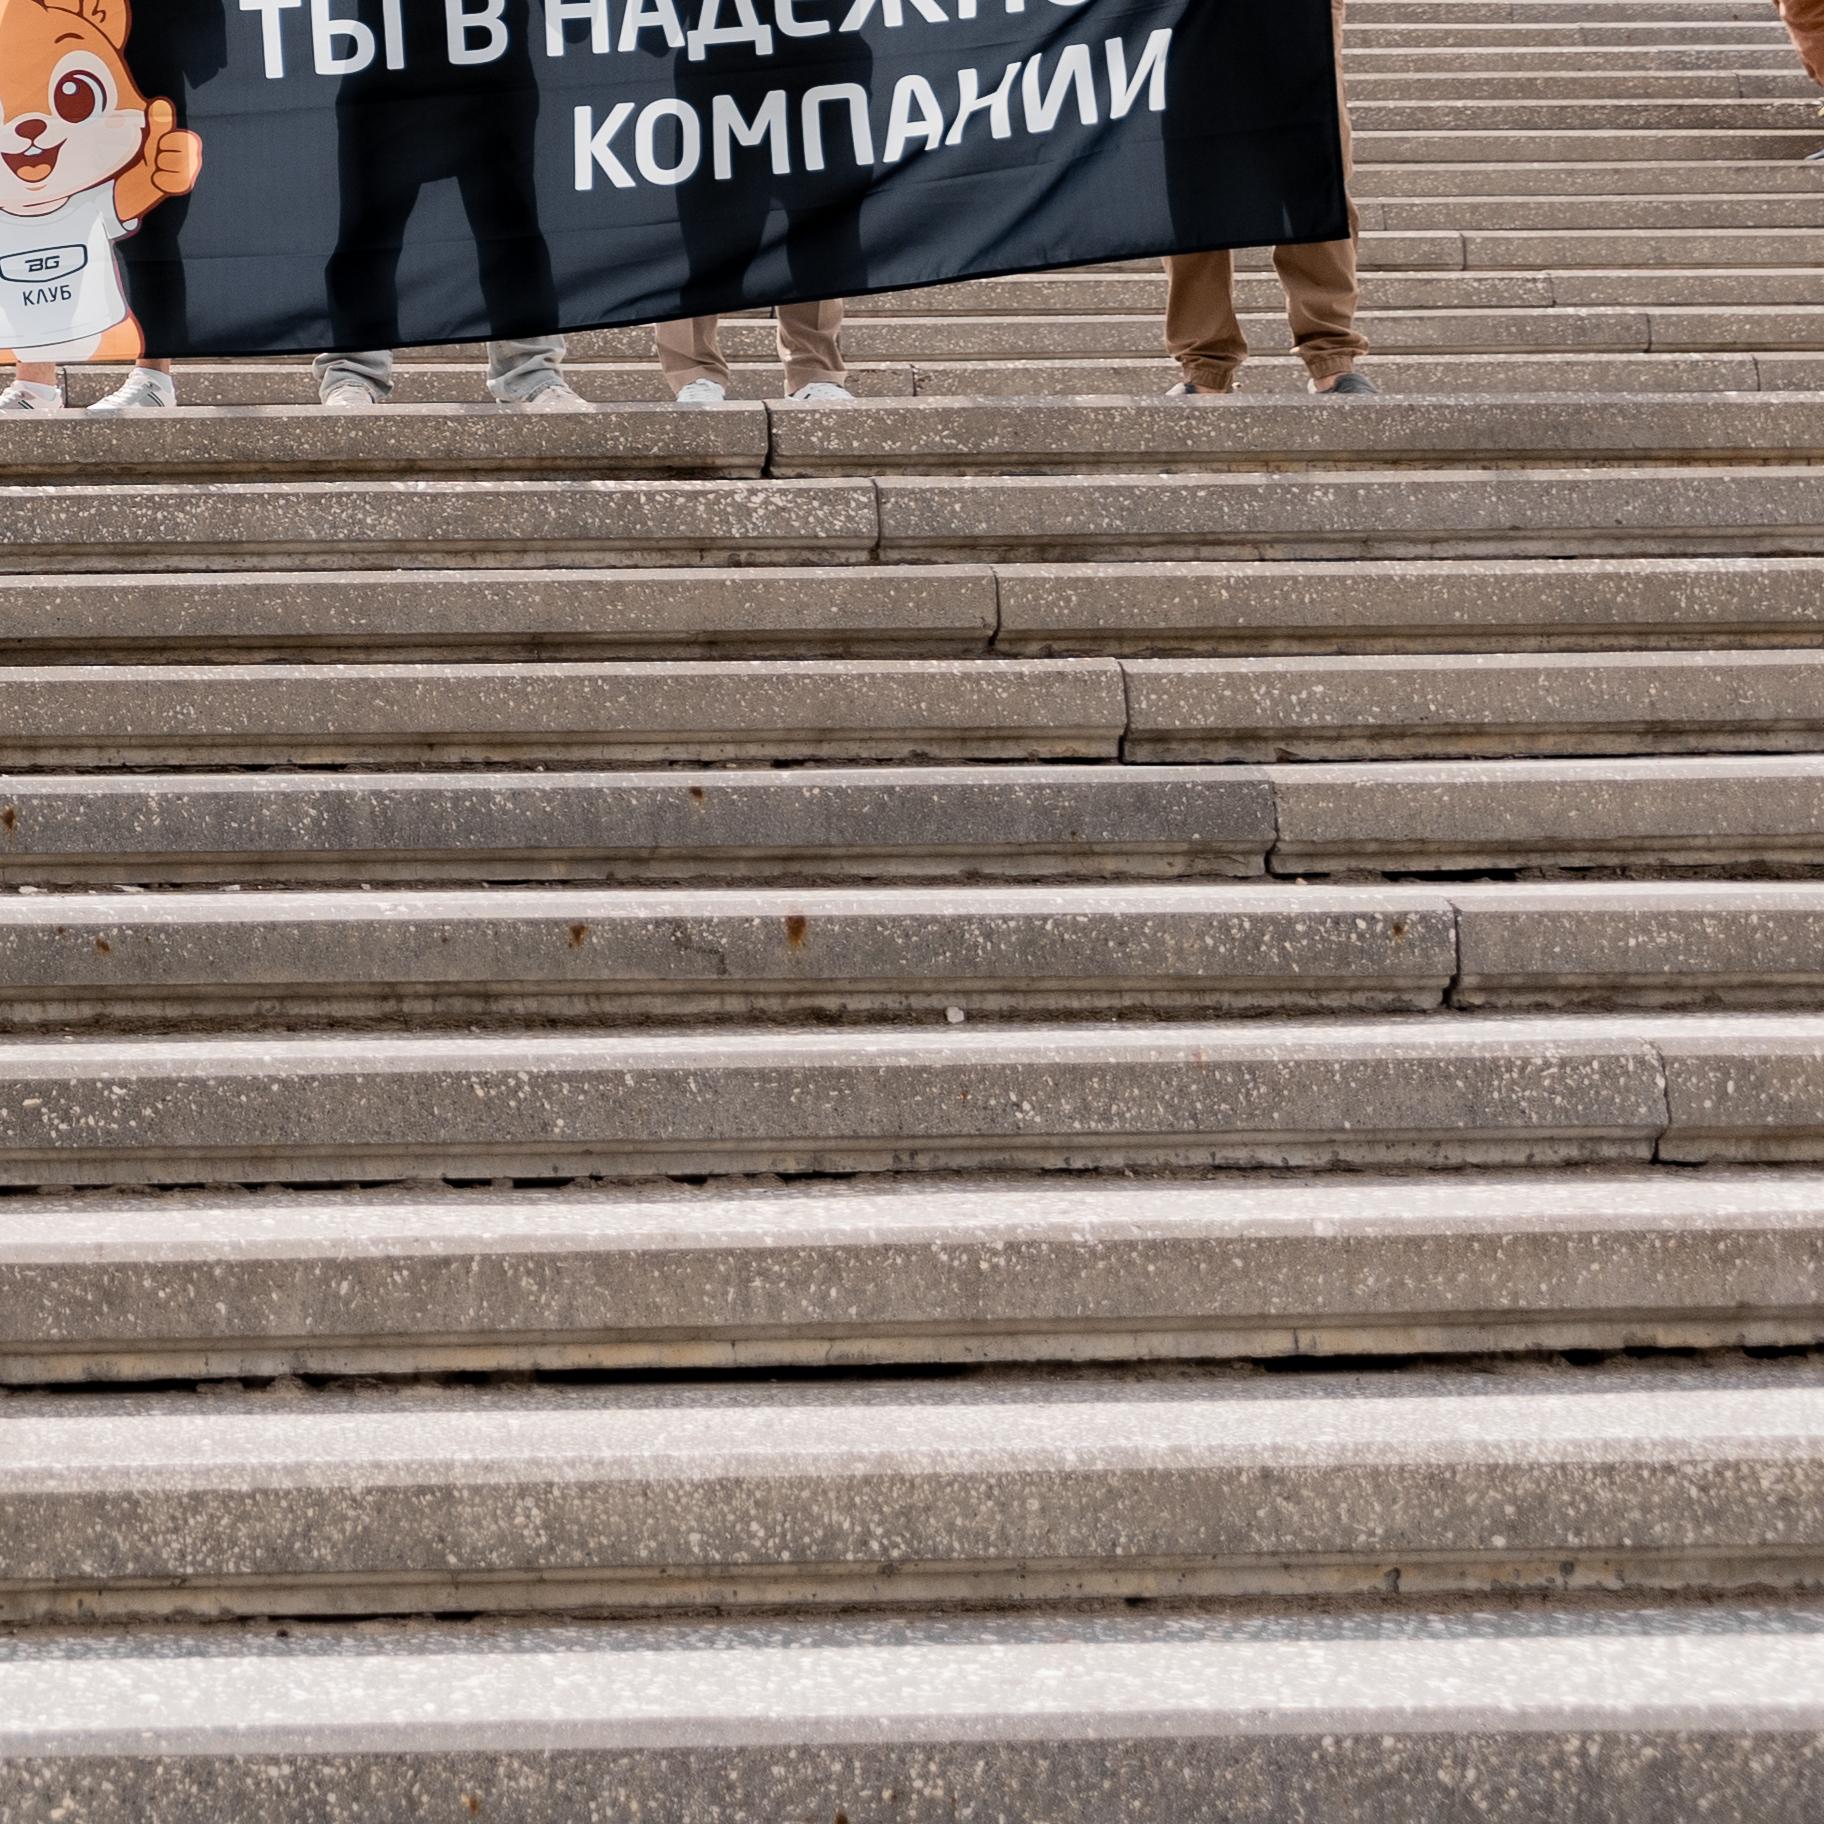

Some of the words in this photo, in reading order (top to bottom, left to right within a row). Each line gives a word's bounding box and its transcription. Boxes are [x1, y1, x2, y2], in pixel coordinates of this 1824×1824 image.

[572, 27, 1174, 192] КОМПАНИИ
[24, 255, 61, 273] BG
[22, 284, 72, 307] КЛУБ
